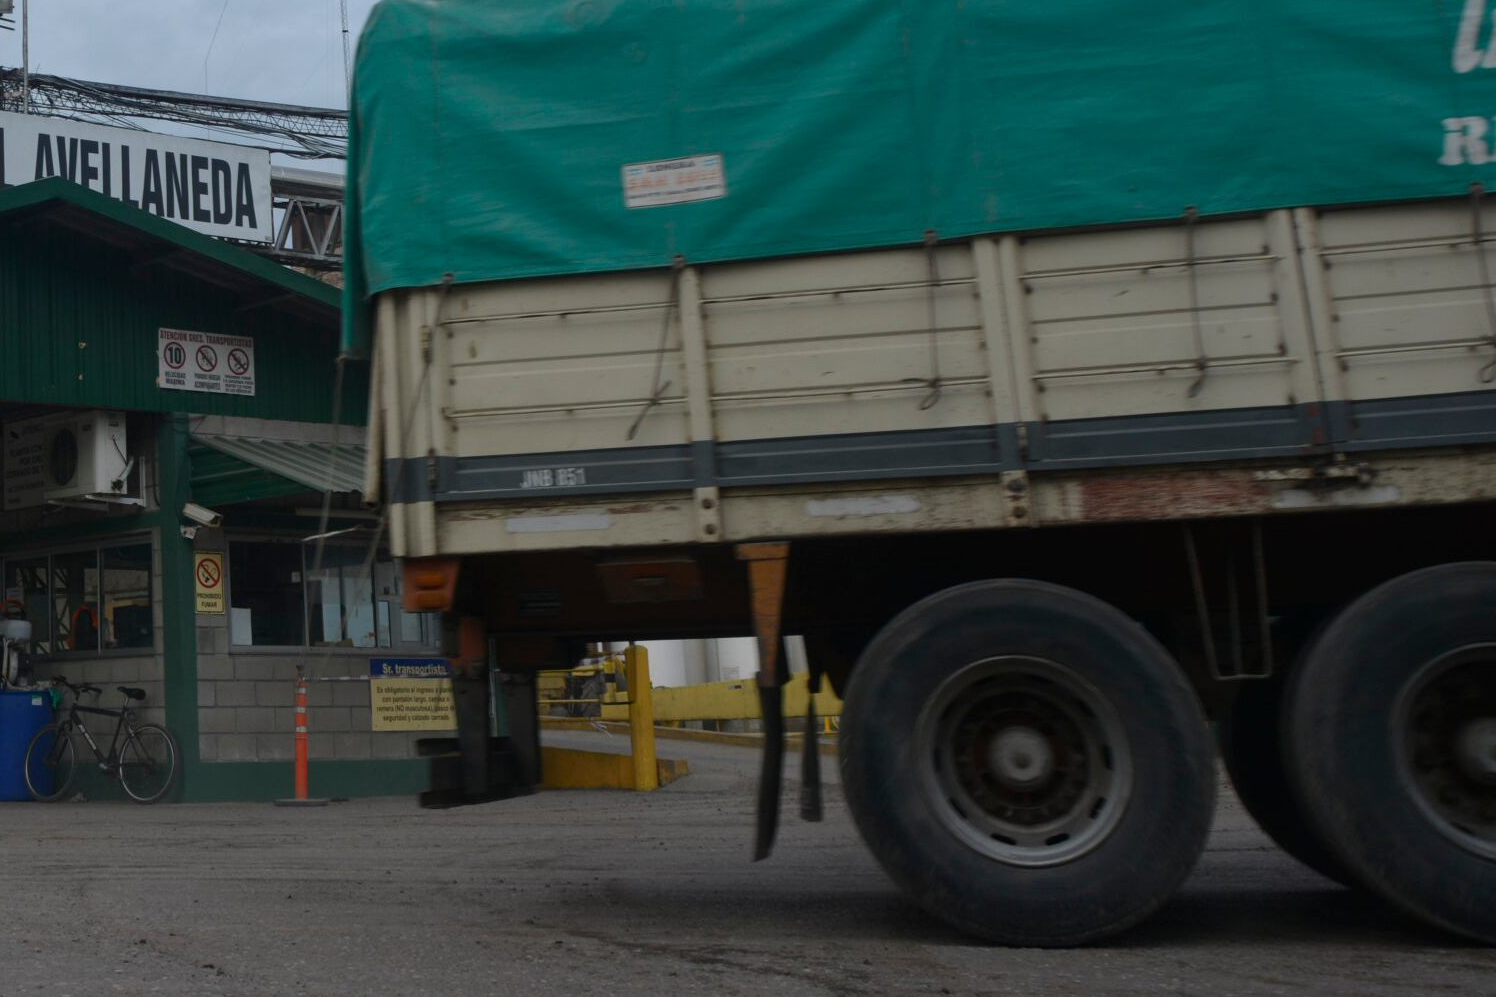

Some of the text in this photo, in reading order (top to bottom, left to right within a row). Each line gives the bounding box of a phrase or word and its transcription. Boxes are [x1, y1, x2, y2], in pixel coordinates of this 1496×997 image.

[35, 133, 257, 229] AVELLANEDA
[167, 347, 182, 364] 10
[382, 663, 393, 674] Sr.
